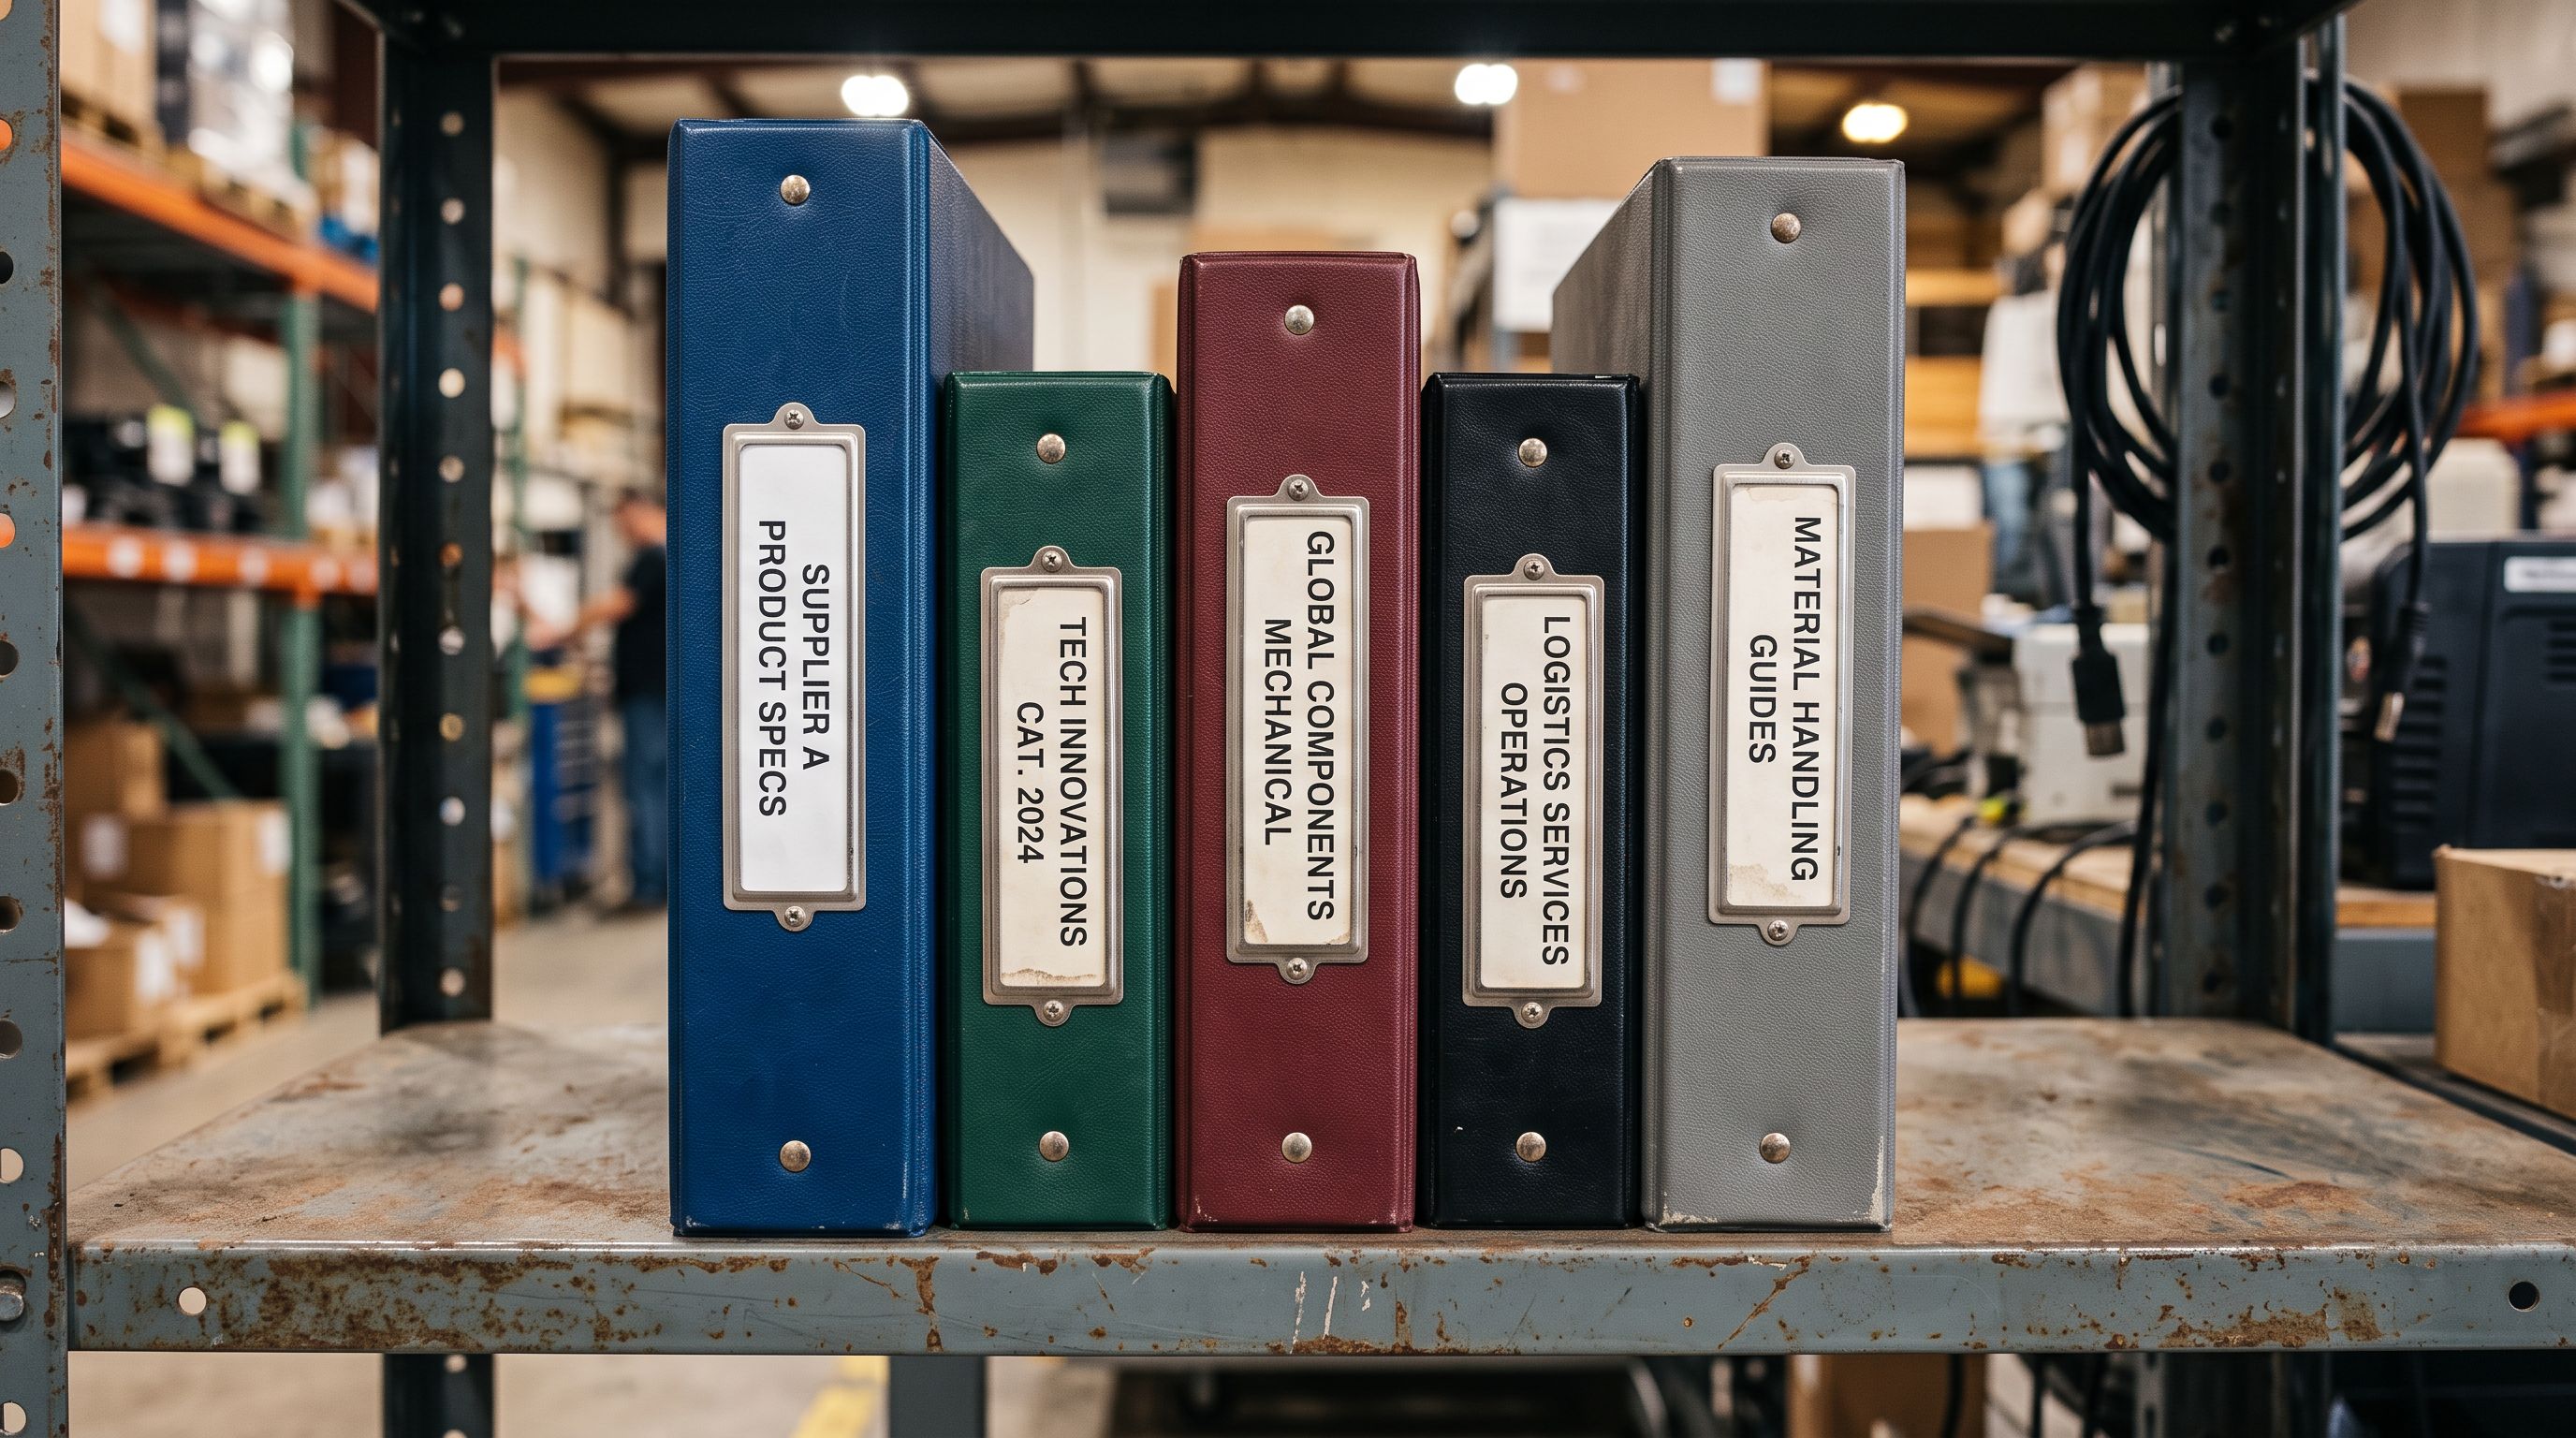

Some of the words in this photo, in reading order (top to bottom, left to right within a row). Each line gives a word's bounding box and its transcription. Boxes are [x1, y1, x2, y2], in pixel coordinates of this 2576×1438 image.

[758, 521, 787, 691] PRODUCT
[802, 564, 831, 735] SUPPLIER
[1060, 616, 1088, 706] TECH
[1307, 531, 1335, 670] GLOBAL
[1793, 517, 1822, 691] MATERIAL
[758, 701, 787, 816] SPECS
[802, 746, 830, 770] A
[1017, 701, 1045, 775] CAT.
[1264, 619, 1293, 845] MECHANICAL
[1544, 616, 1571, 791] LOGISTICS
[1749, 634, 1778, 764] GUIDES
[1017, 787, 1045, 864] 2024
[1059, 718, 1088, 946] INNOVATIONS
[1306, 680, 1335, 920] COMPONENTS
[1500, 682, 1529, 899] OPERATIONS
[1791, 702, 1820, 881] HANDLING
[1542, 802, 1571, 965] SERVICES
